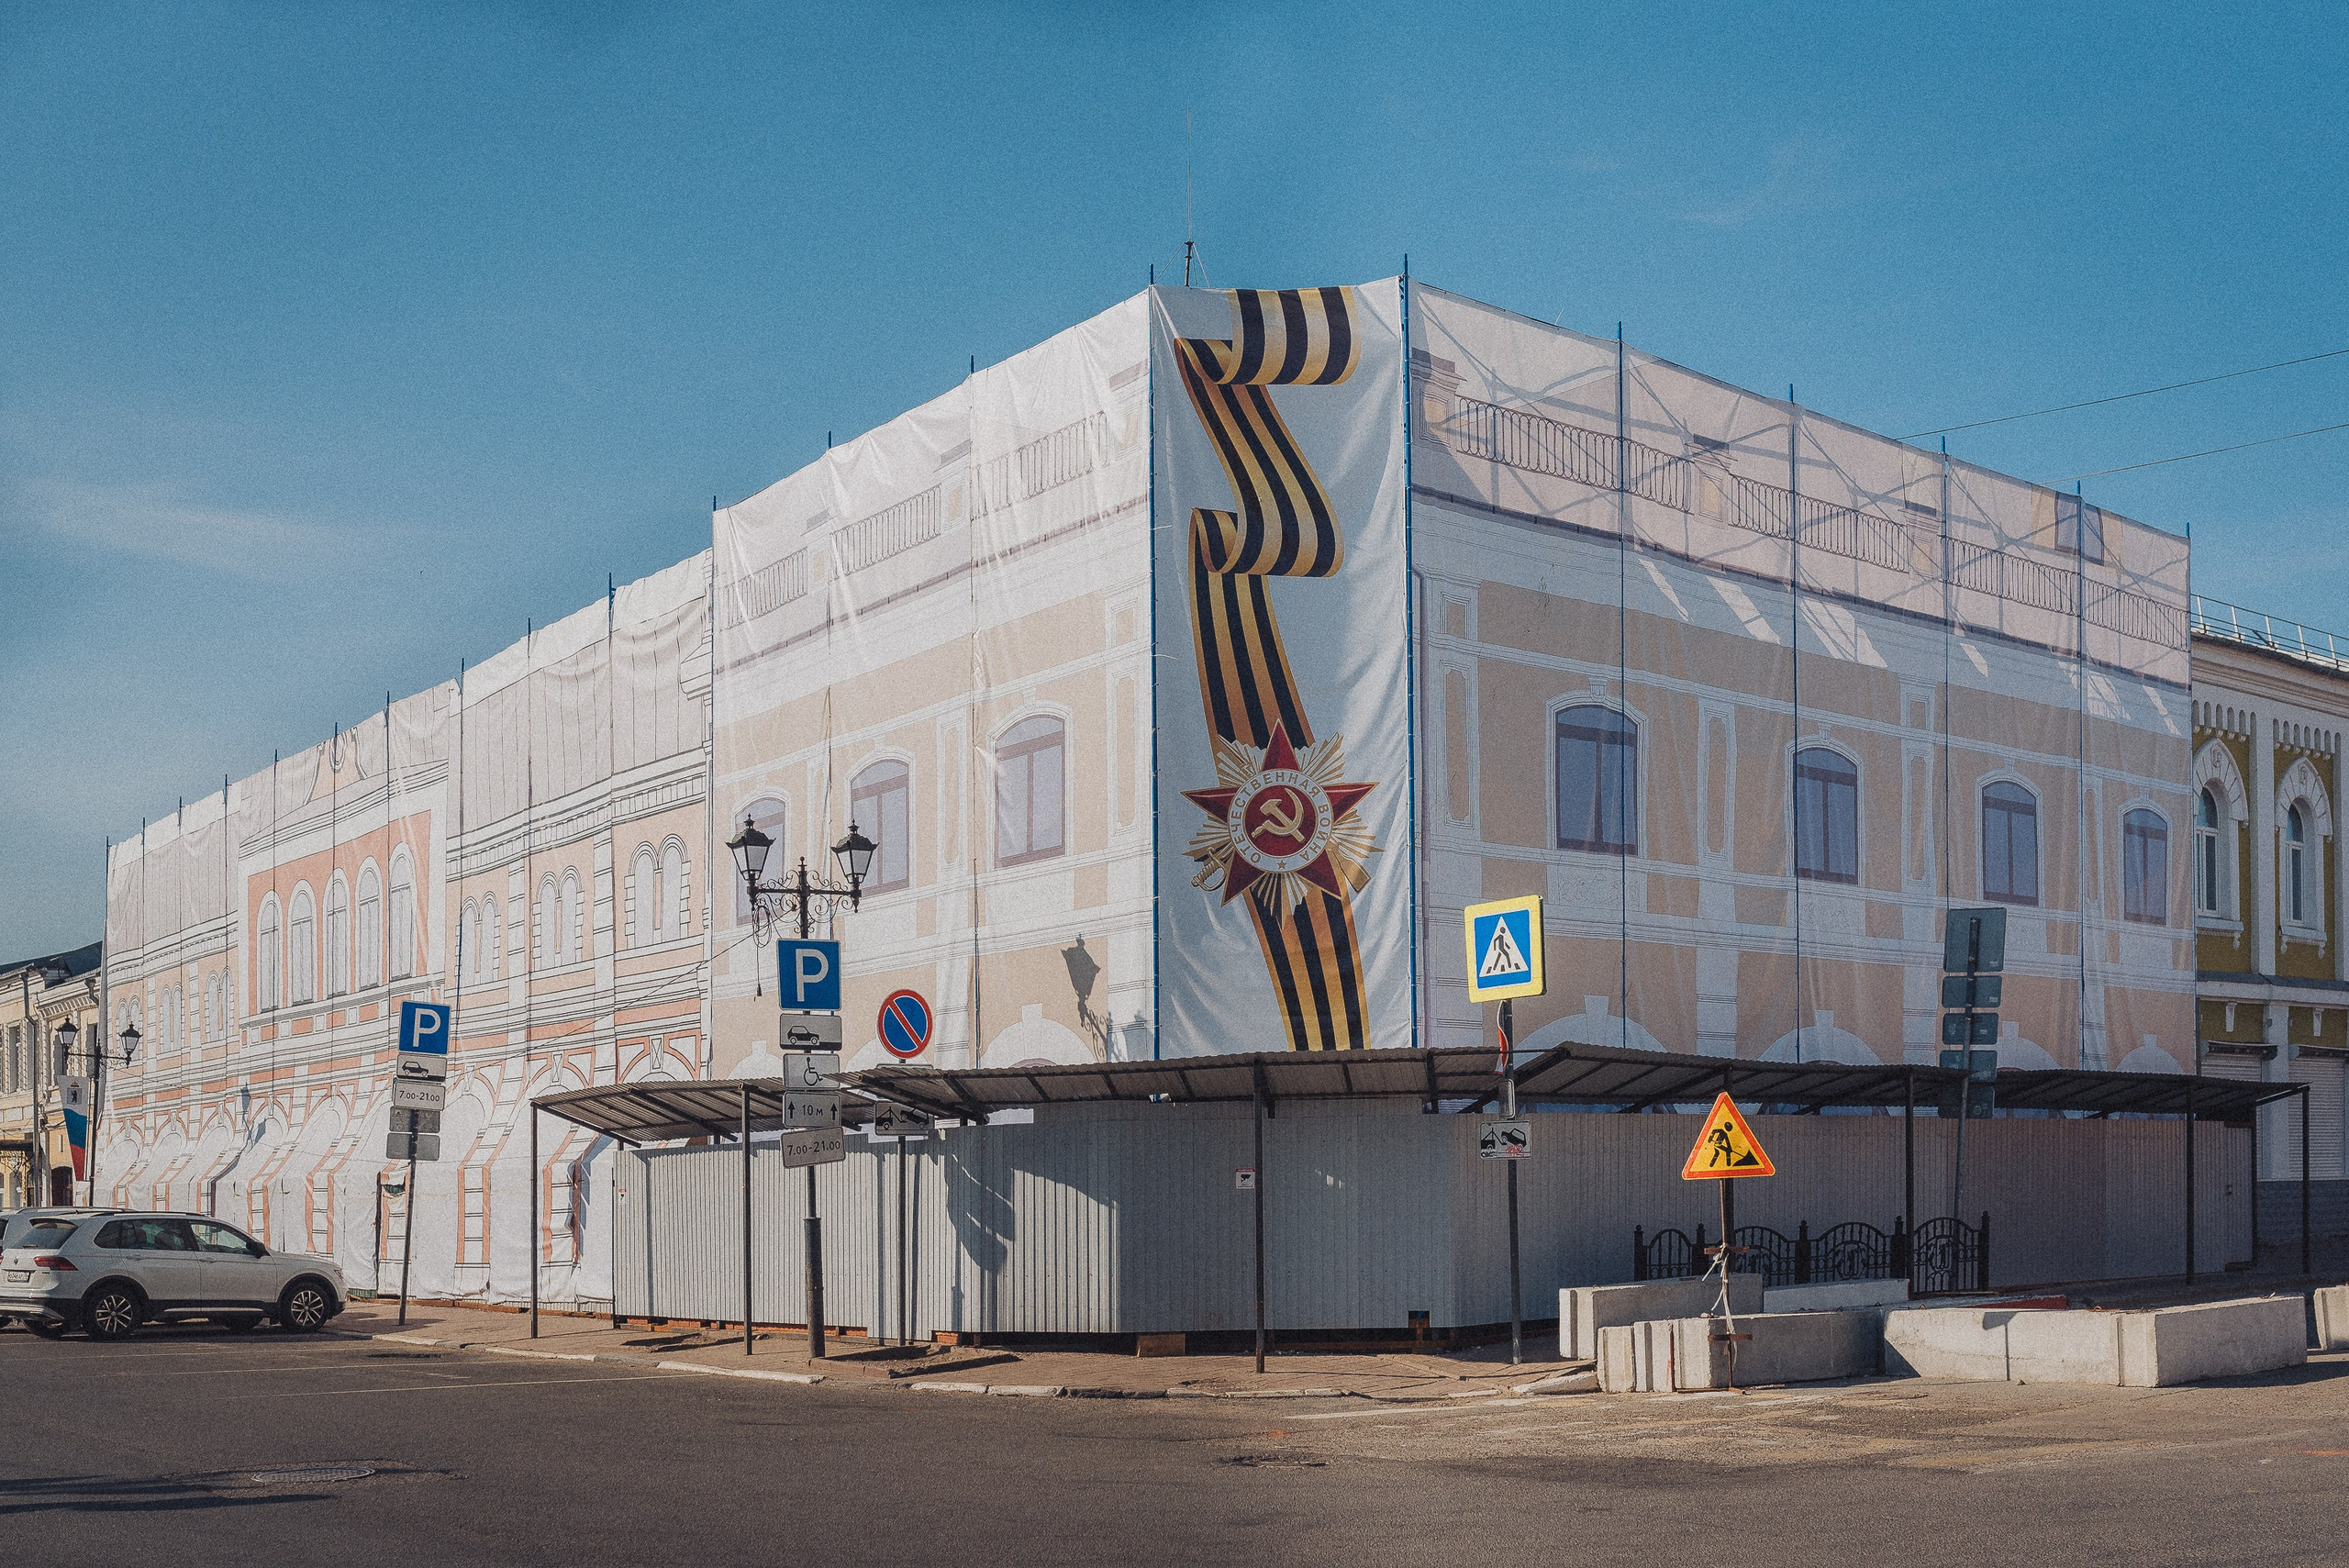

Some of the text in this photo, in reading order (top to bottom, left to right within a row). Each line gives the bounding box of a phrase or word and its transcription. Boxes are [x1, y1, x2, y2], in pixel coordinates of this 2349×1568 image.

[1230, 771, 1331, 863] ОТЕЧЕСТВЕННАЯ ВОЙНА
[795, 948, 829, 1002] P
[412, 1007, 441, 1048] P
[398, 1090, 440, 1102] 7.00-21.00
[802, 1104, 814, 1117] 10
[786, 1140, 841, 1156] 7.00-21.00
